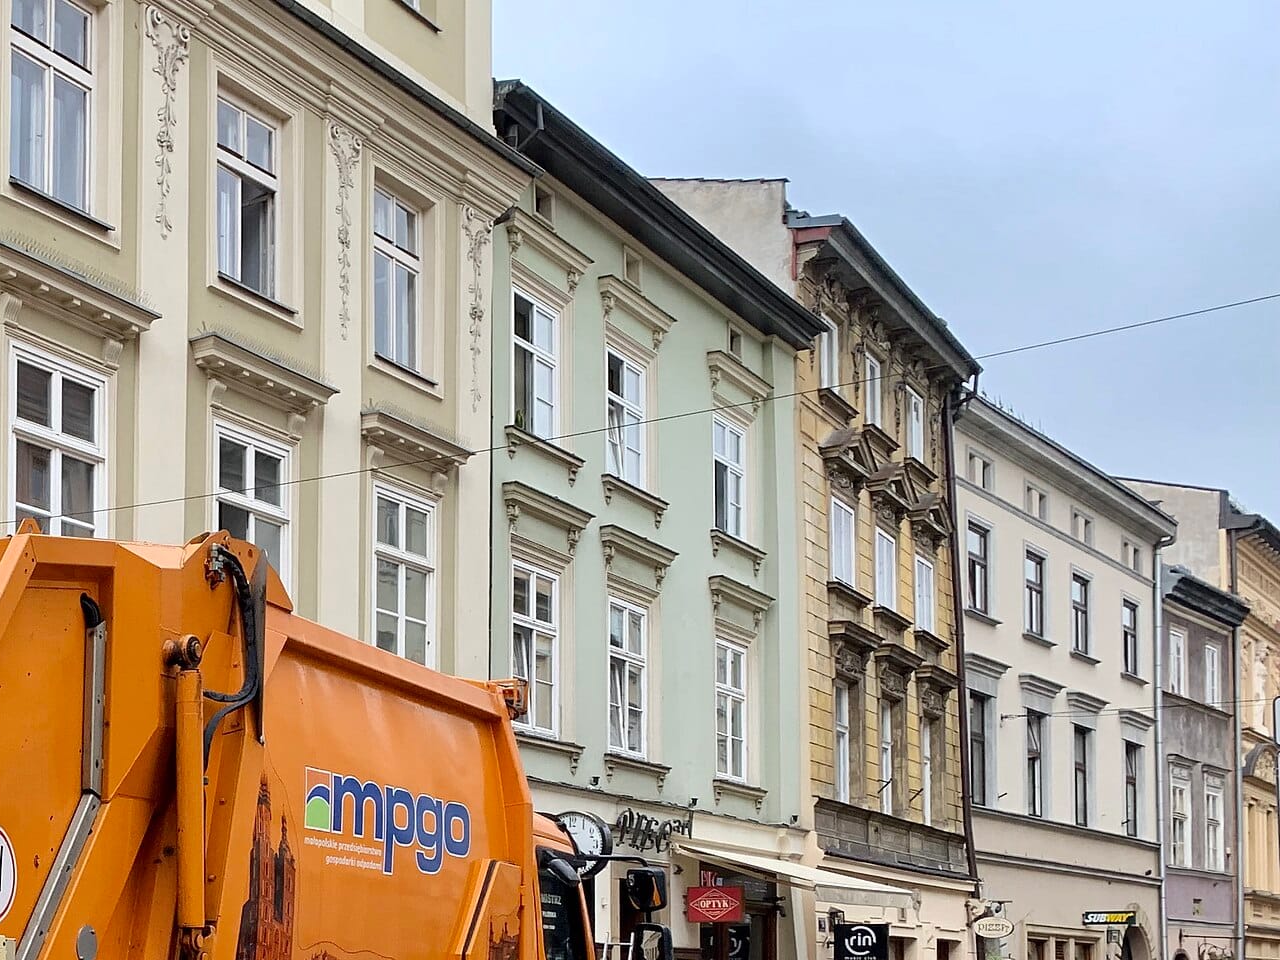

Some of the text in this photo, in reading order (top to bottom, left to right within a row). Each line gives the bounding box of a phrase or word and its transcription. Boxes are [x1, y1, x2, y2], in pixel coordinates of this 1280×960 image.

[332, 773, 471, 875] mpgo
[700, 899, 729, 909] OPTYK
[1085, 913, 1135, 923] SUBWAY
[850, 932, 872, 946] rin
